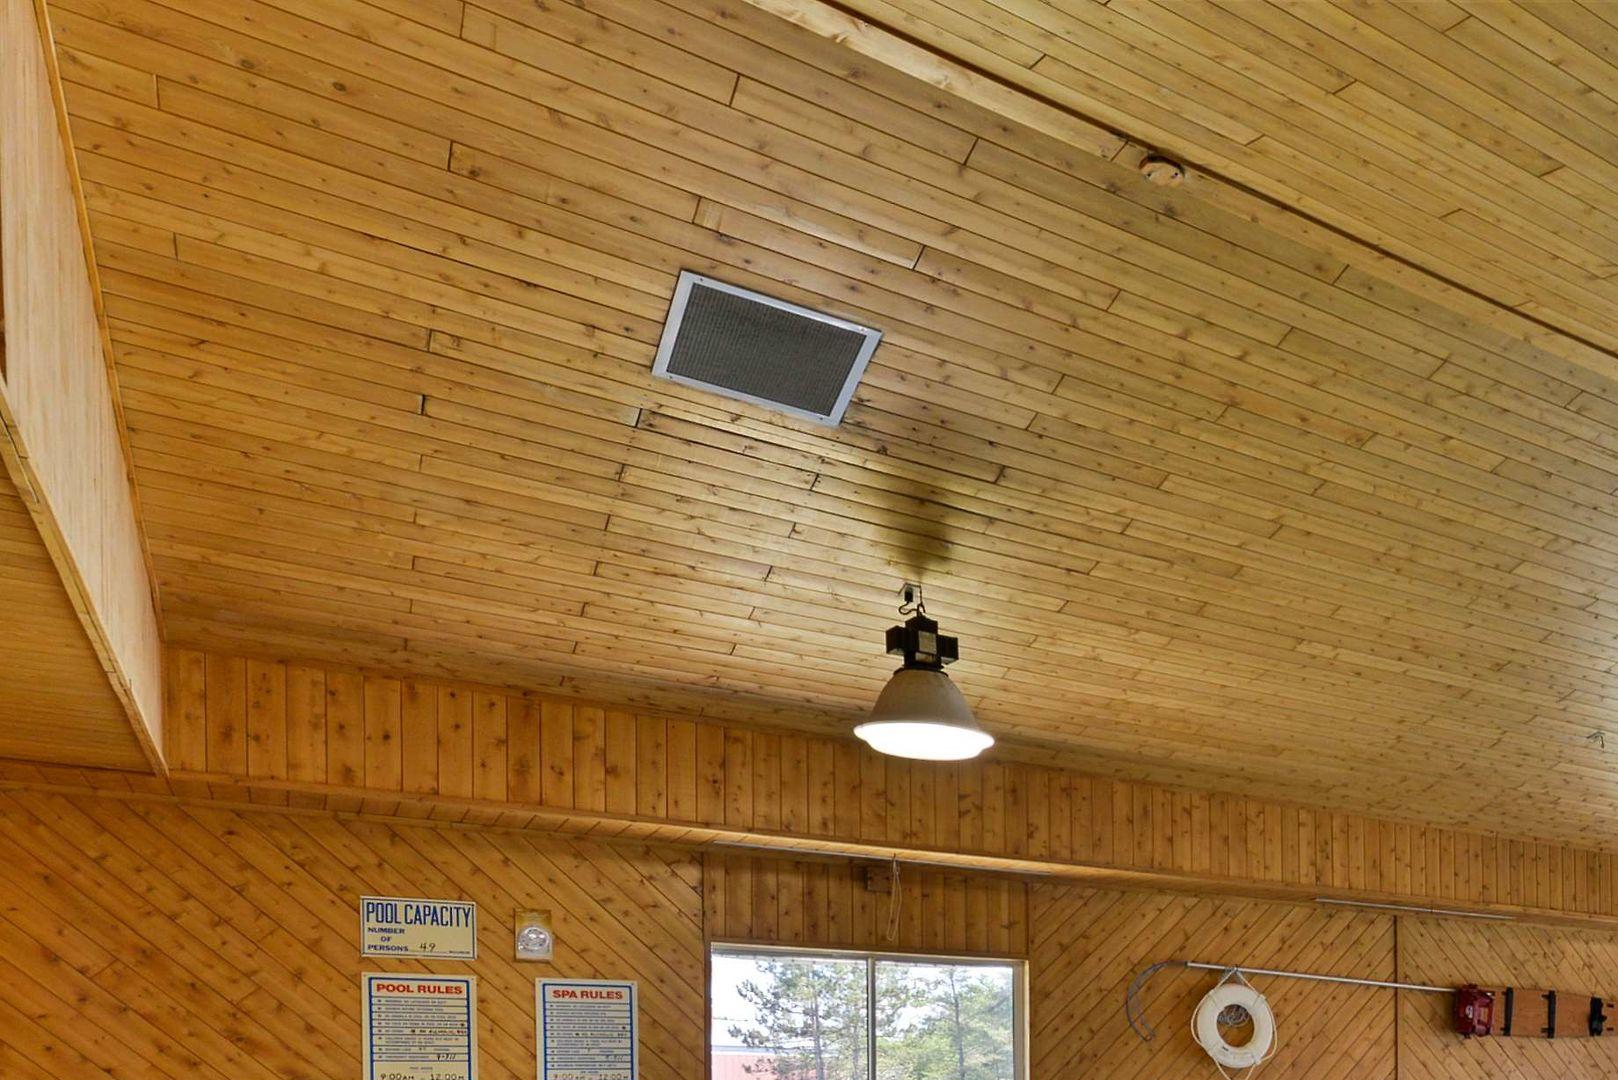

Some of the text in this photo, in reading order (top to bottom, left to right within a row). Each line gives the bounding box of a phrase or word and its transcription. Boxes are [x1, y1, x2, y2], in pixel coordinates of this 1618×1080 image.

[366, 902, 471, 928] POOL CAPACITY
[367, 927, 405, 935] NUMBER
[367, 944, 409, 952] PERSONS
[376, 983, 463, 995] POOL RULES
[552, 989, 624, 1000] SPA RULES
